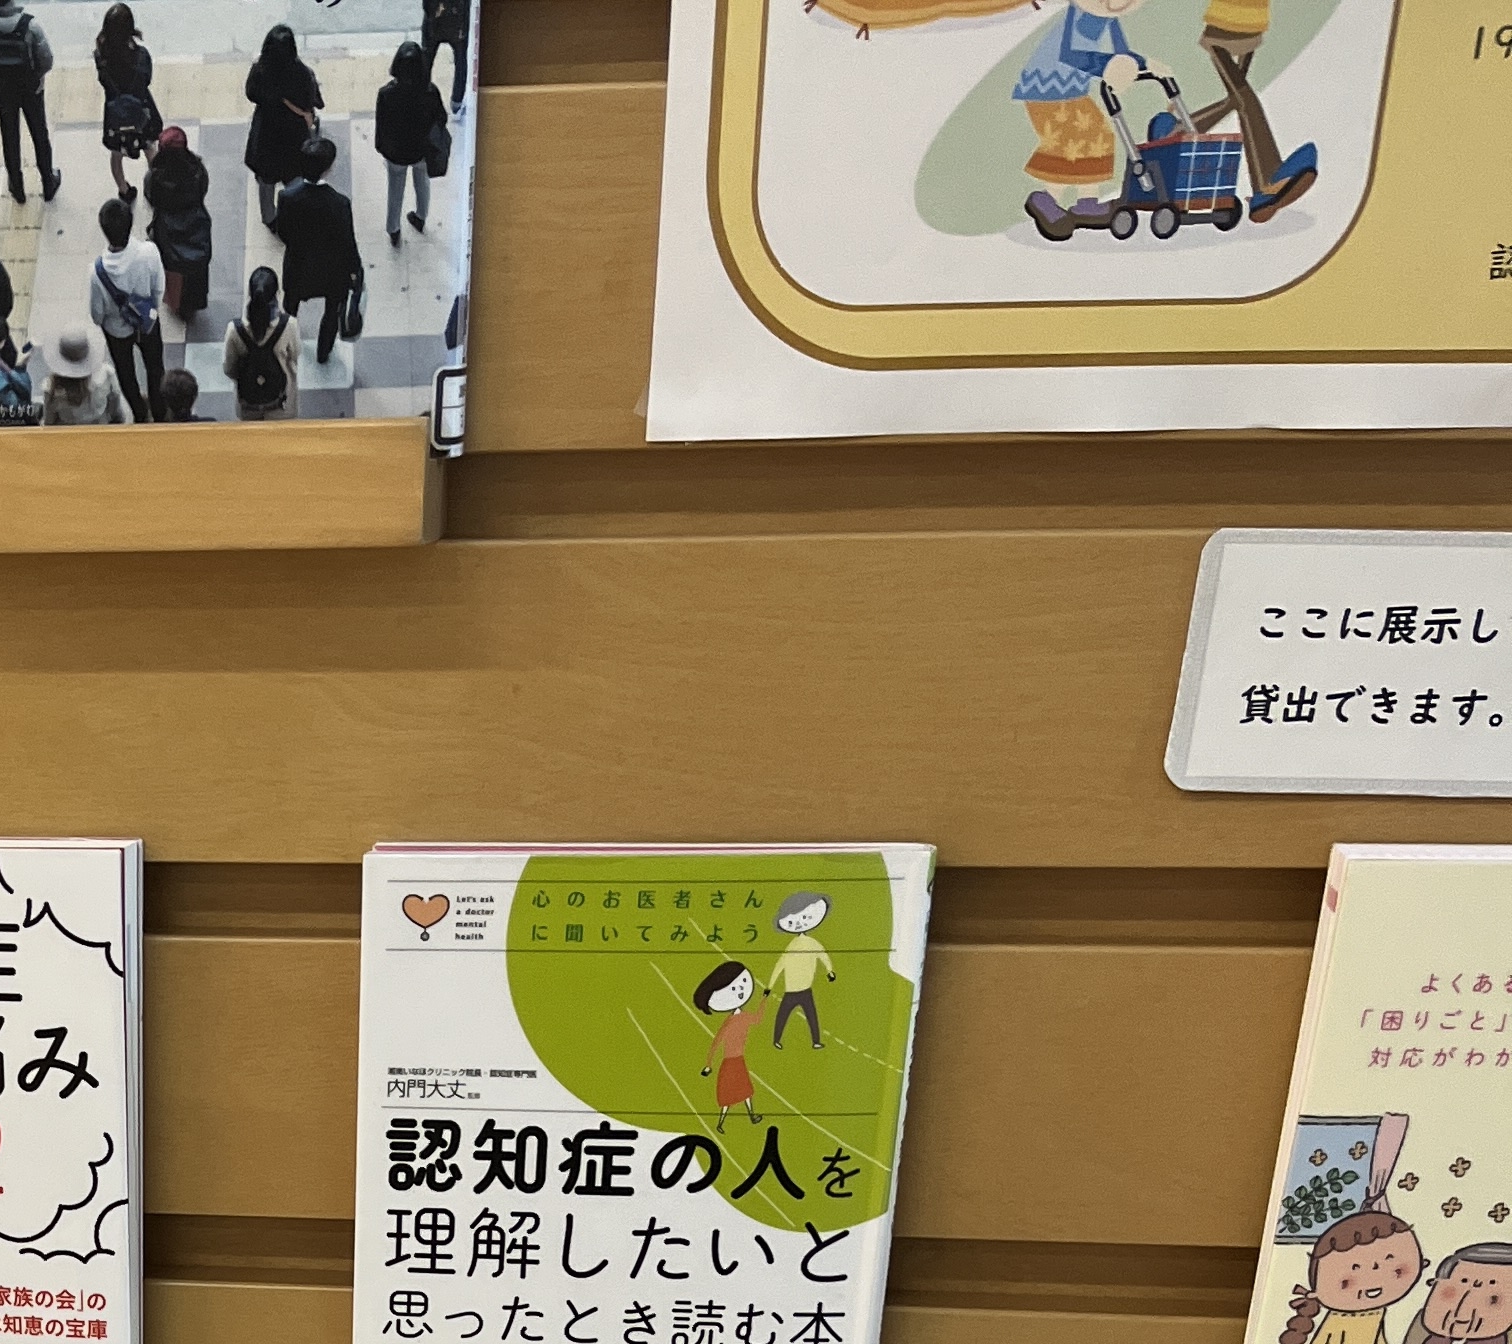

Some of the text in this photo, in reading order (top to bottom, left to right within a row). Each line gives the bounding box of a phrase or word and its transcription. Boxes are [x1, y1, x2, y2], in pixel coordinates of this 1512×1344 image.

[1258, 605, 1512, 646] ここに展示し
[1239, 684, 1507, 729] 貸出できます。
[532, 889, 763, 909] 心のお医者さん
[531, 924, 760, 944] に聞いてみよう
[386, 1116, 862, 1200] 認知症の人を
[385, 1206, 851, 1283] 理解したいと
